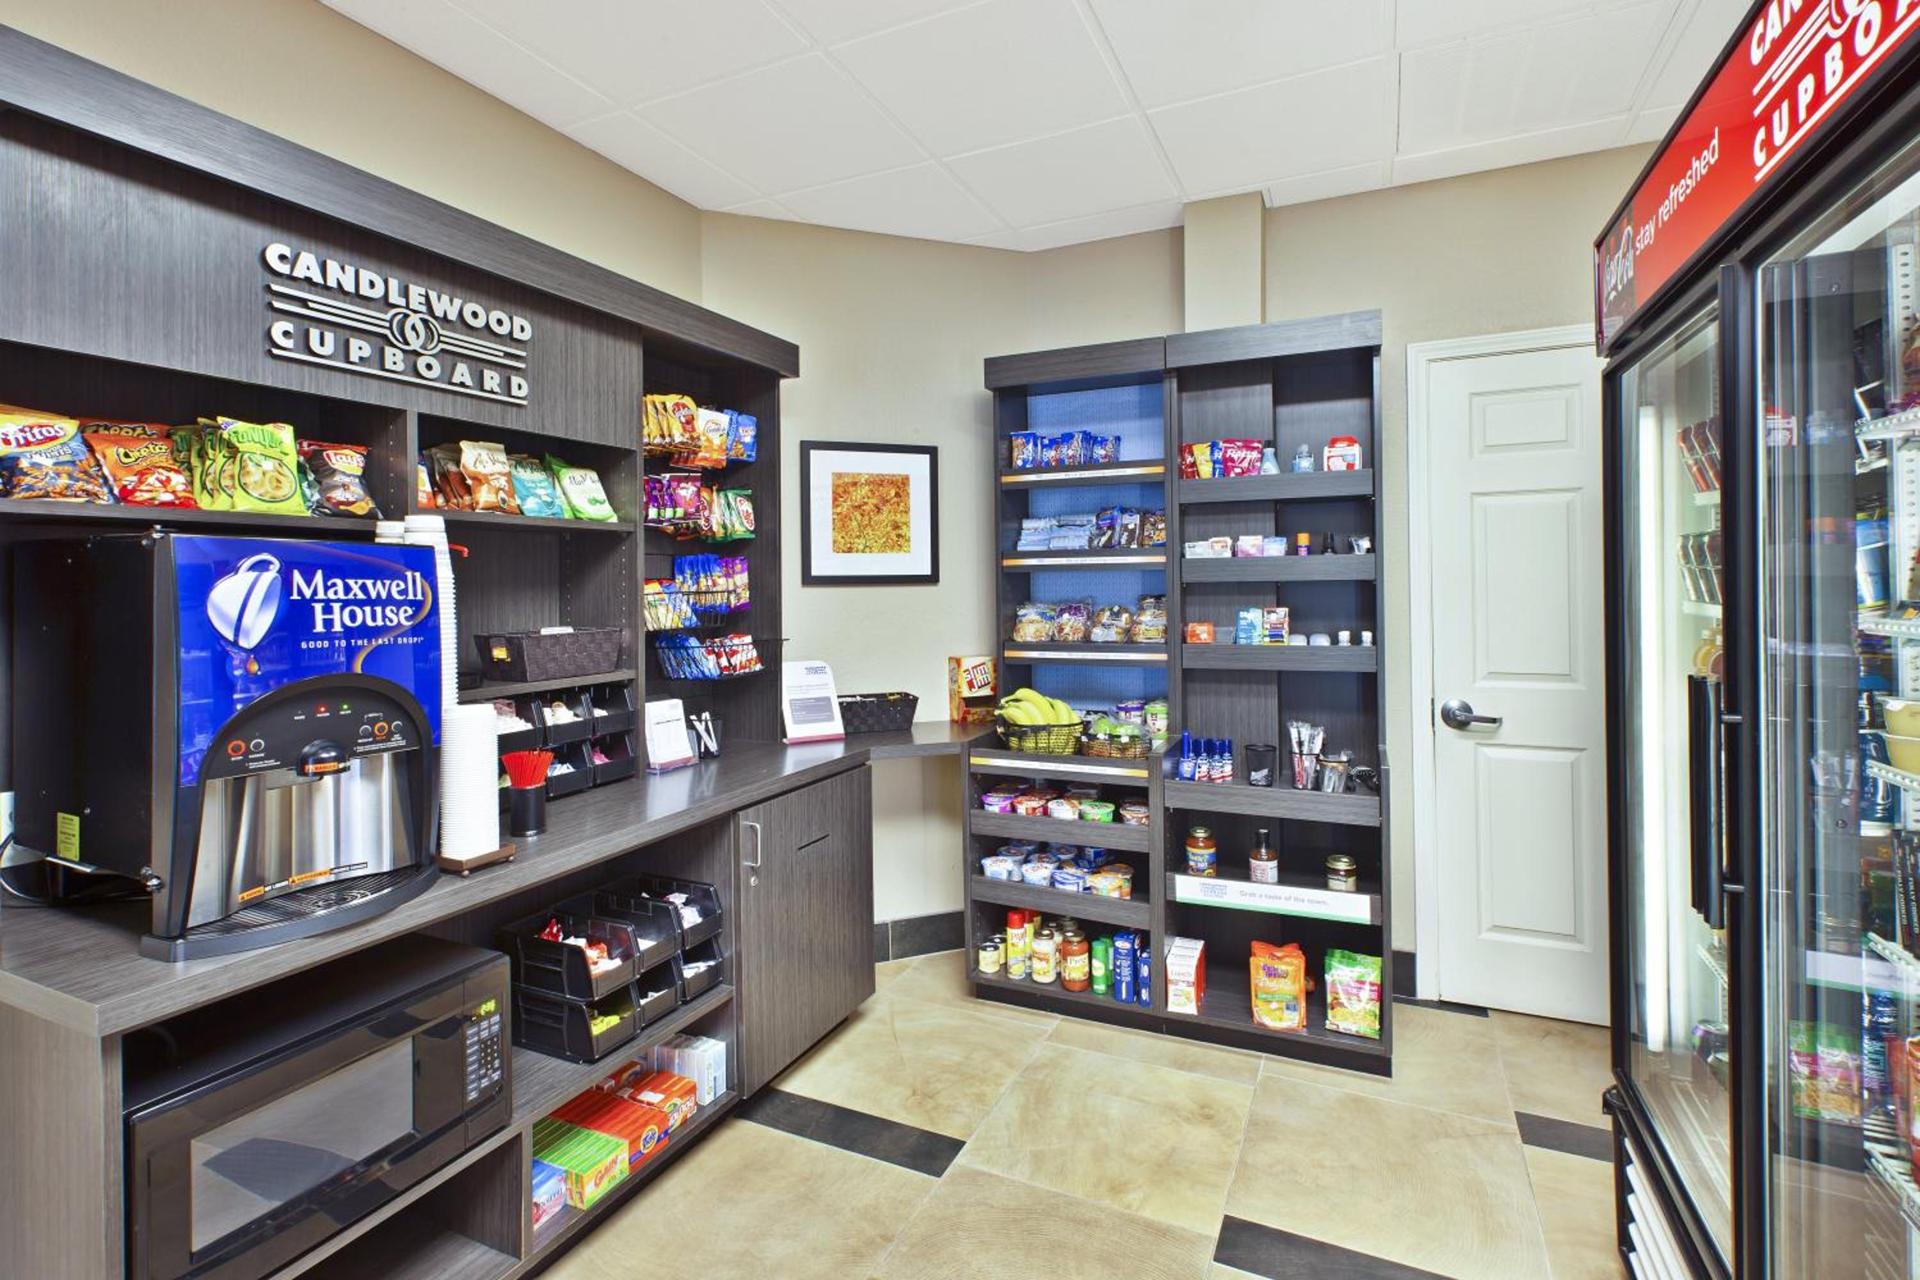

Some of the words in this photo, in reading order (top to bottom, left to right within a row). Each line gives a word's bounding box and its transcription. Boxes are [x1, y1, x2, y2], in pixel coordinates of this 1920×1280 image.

[1635, 214, 1656, 256] stay
[1658, 126, 1719, 229] refreshed
[264, 243, 532, 342] CANDLEWOOD
[270, 320, 529, 399] CUPBOARD
[290, 569, 424, 600] Maxwell
[301, 641, 329, 649] GOOD
[335, 640, 346, 648] TO
[351, 639, 368, 647] THE
[372, 637, 394, 645] LAST
[311, 602, 414, 633] House
